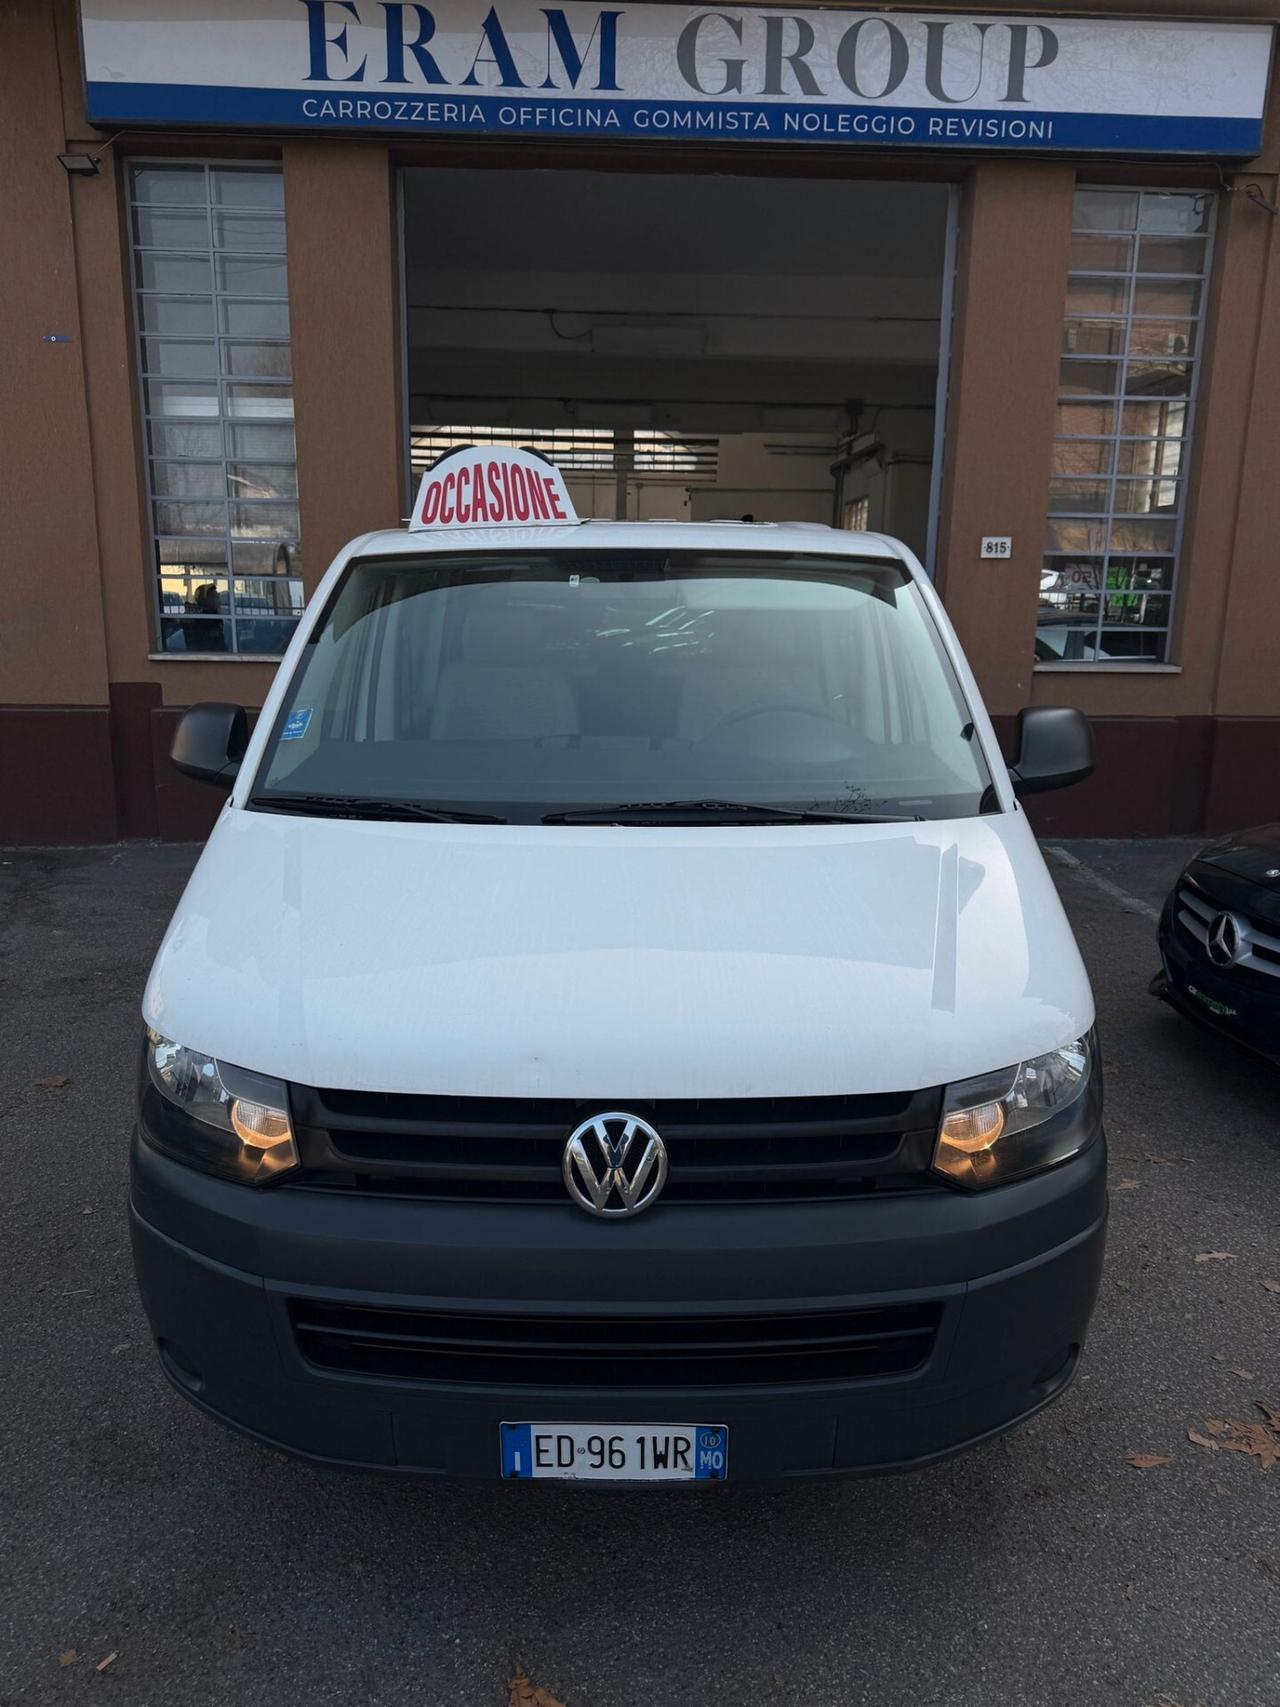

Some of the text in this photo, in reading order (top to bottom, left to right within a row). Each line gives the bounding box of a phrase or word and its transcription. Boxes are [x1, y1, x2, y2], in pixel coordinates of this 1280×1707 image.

[301, 0, 1059, 103] ERAM GROUP
[302, 99, 1054, 139] CARROZZERIA OFFICINA GOMMISTA NOLEGGIO REVISIONI
[421, 461, 567, 525] OCCASIONE
[984, 541, 1008, 554] 815
[699, 1450, 724, 1470] MO
